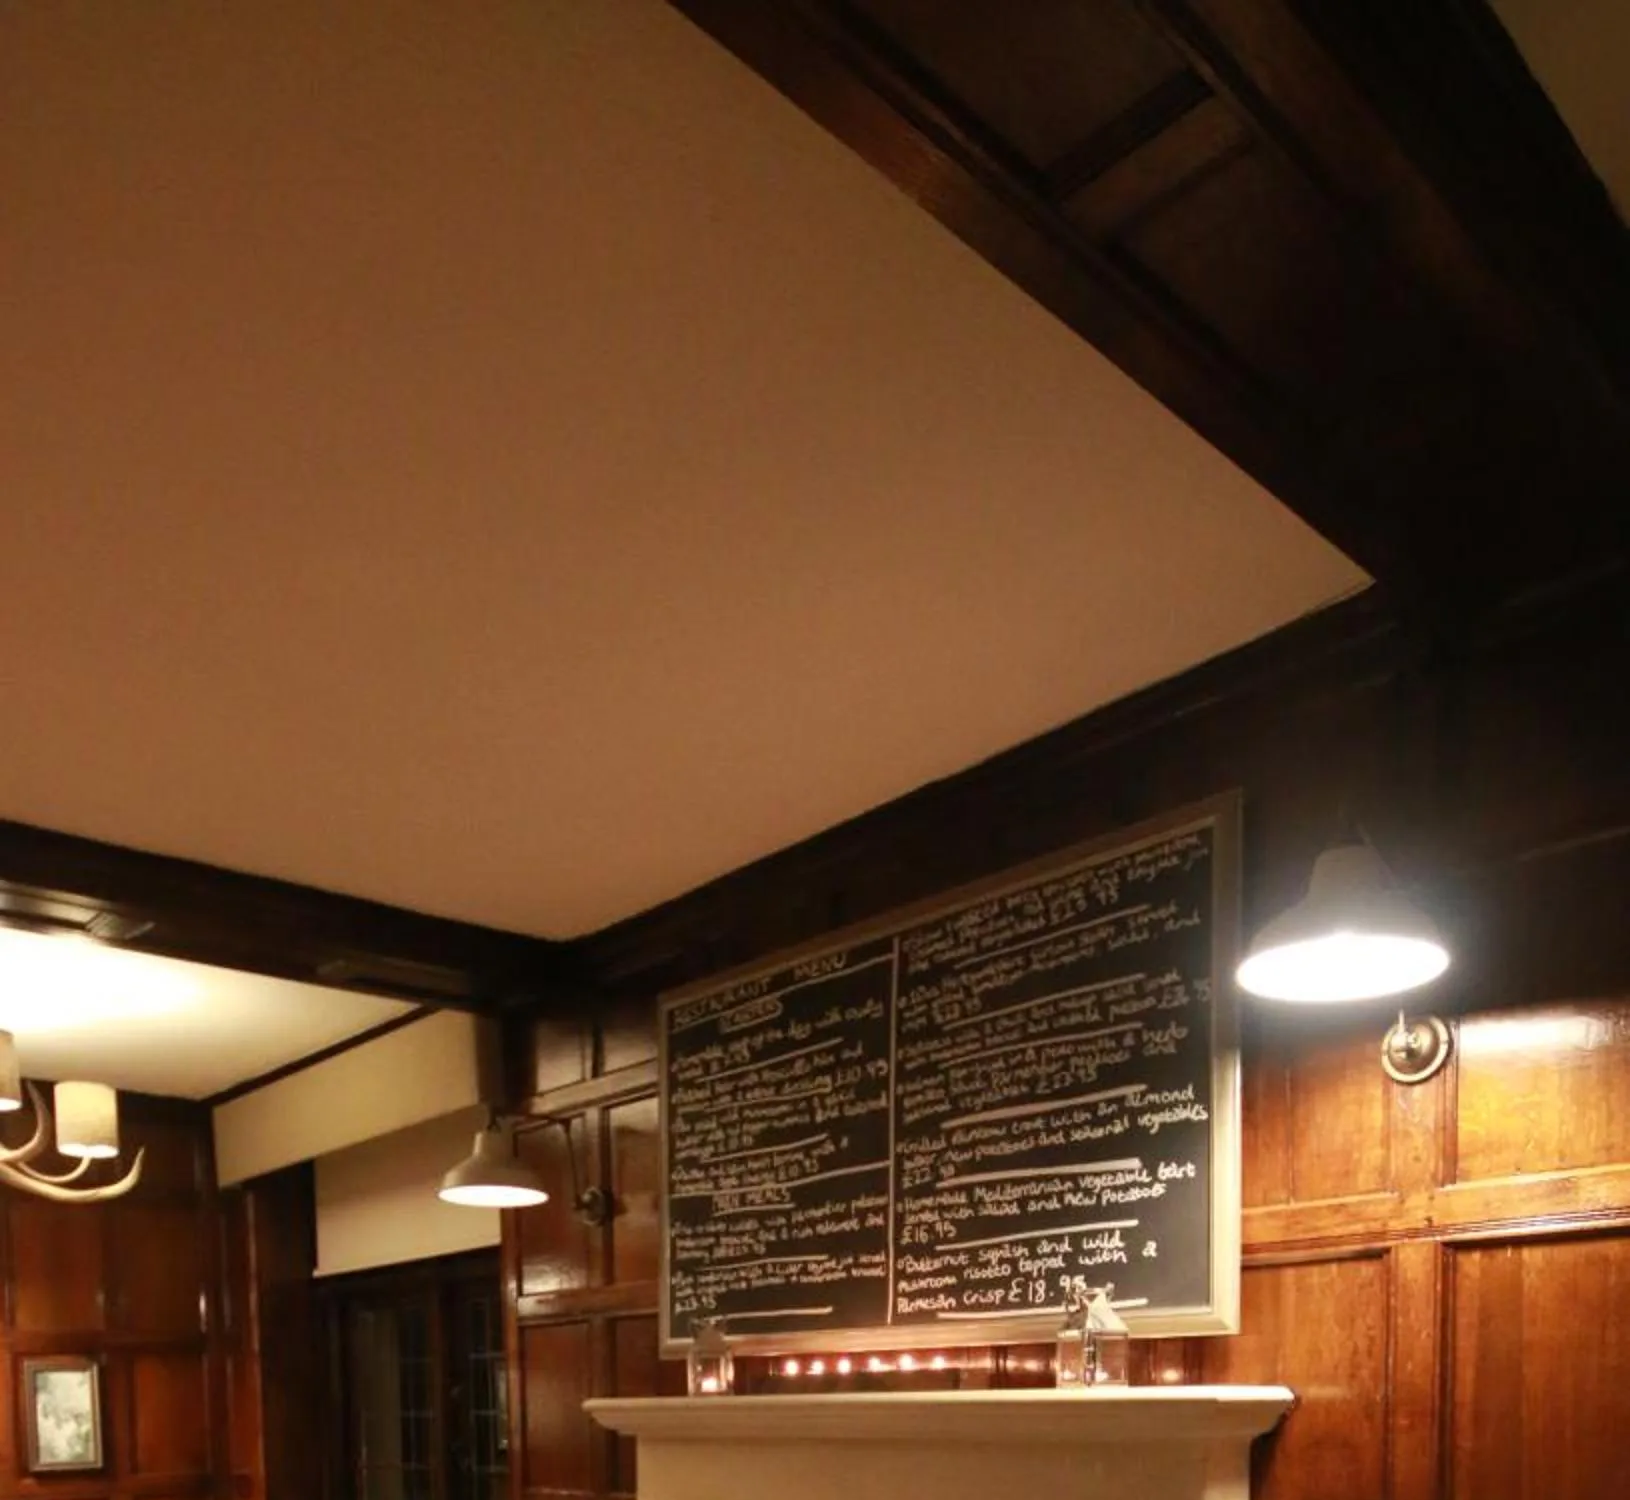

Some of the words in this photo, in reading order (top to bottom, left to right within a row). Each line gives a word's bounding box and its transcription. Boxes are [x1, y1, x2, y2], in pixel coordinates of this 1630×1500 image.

[793, 952, 846, 980] MENU
[1038, 1130, 1066, 1146] and
[1137, 1103, 1208, 1135] vegetables
[1049, 1110, 1093, 1129] with
[1097, 1102, 1119, 1118] an
[1124, 1082, 1196, 1108] almond
[1079, 1169, 1153, 1194] vegetable
[1157, 1160, 1197, 1181] tart
[941, 1204, 975, 1222] with
[978, 1202, 1021, 1218] salad
[1027, 1197, 1062, 1213] and
[905, 1251, 970, 1275] Butternut
[978, 1245, 1030, 1269] squash
[1037, 1235, 1072, 1256] and
[1082, 1229, 1126, 1251] wild
[963, 1263, 1012, 1280] risotto
[1019, 1255, 1067, 1278] topped
[1078, 1248, 1129, 1266] with
[1141, 1239, 1159, 1259] a
